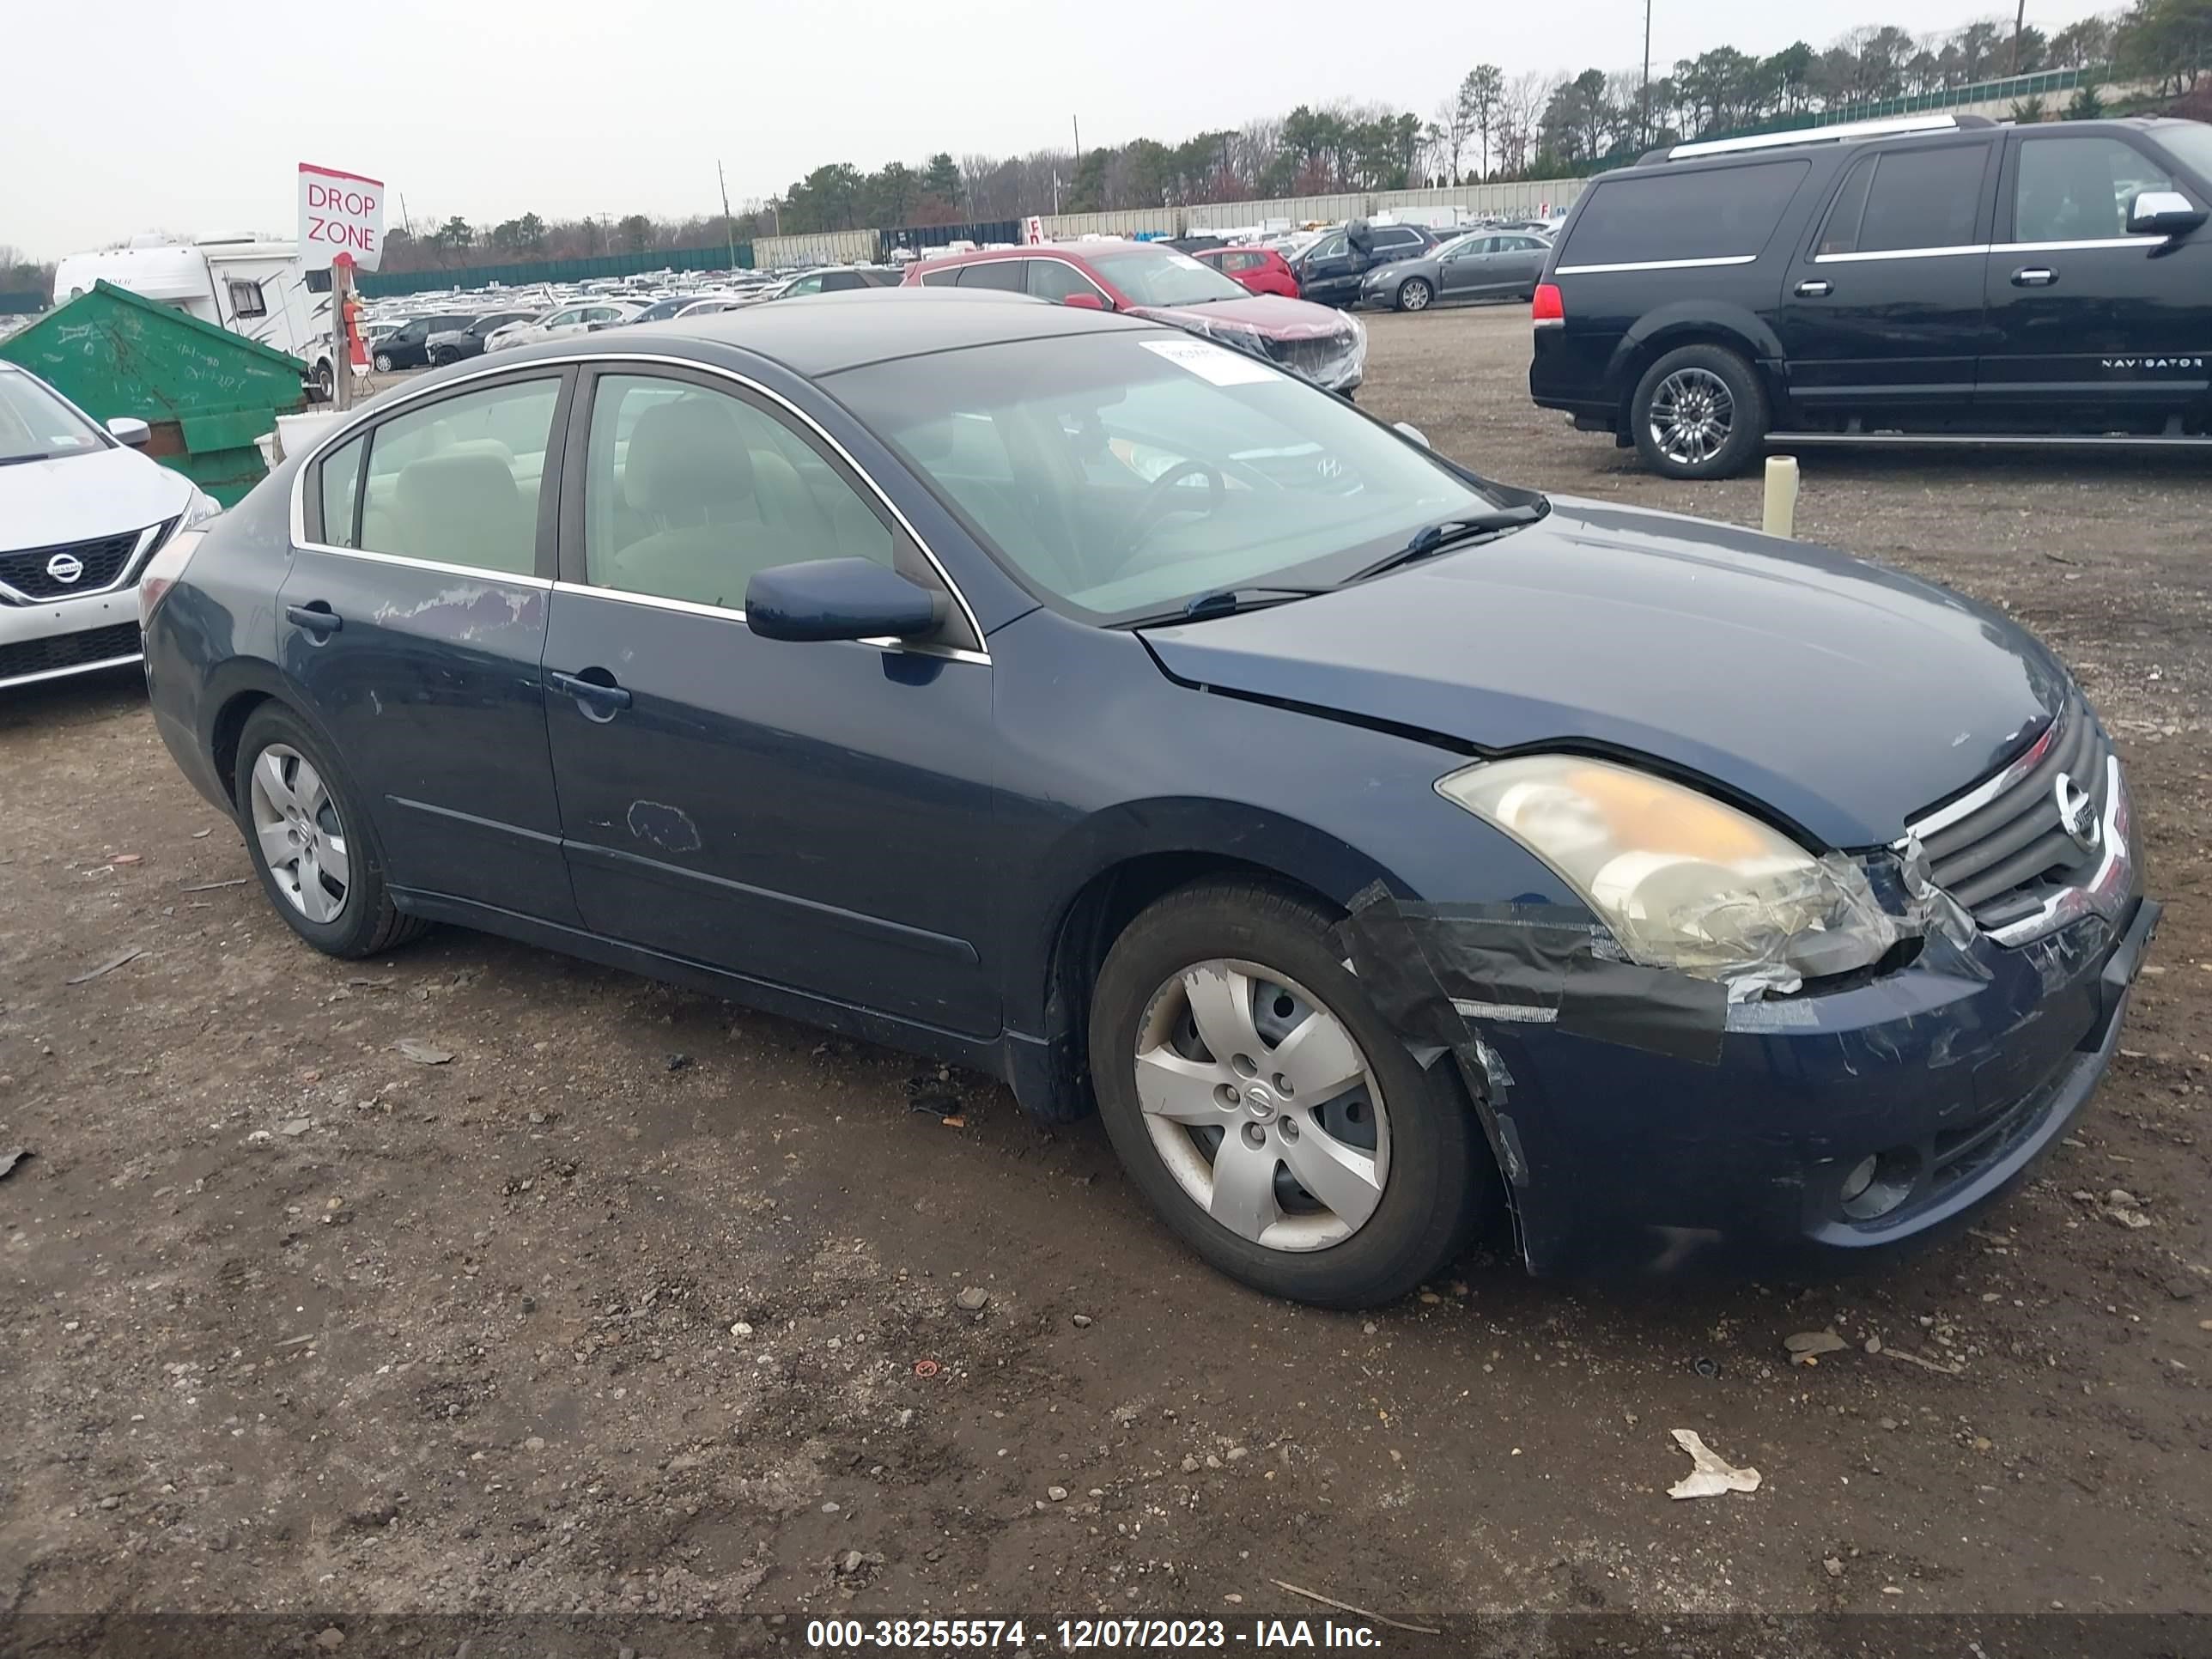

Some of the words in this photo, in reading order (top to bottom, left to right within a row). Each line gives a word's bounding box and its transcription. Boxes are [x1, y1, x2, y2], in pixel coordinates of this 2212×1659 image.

[308, 183, 375, 218] DROP
[308, 216, 374, 252] ZONE
[2102, 358, 2203, 368] NAVIGATOR
[52, 562, 80, 574] NISSAN
